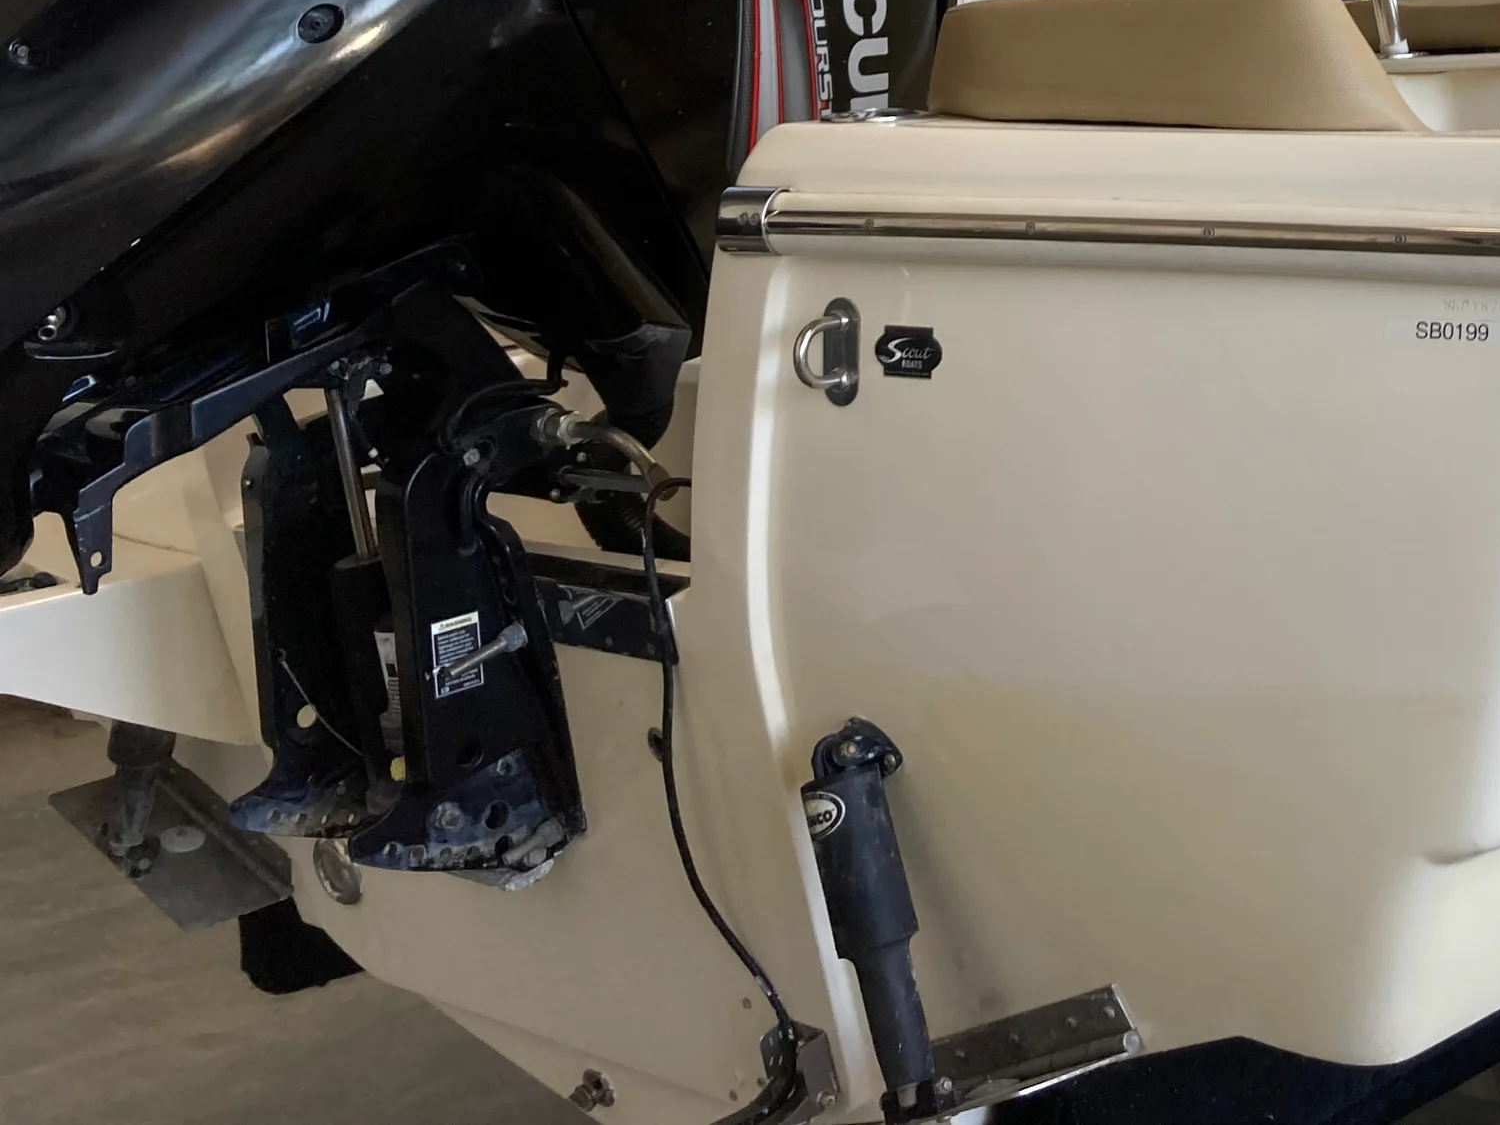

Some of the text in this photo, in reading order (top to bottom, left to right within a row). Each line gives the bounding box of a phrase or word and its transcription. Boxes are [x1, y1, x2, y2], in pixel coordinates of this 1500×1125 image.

[1415, 321, 1490, 342] SB0199
[878, 337, 936, 364] Scout
[807, 810, 833, 827] NCO
